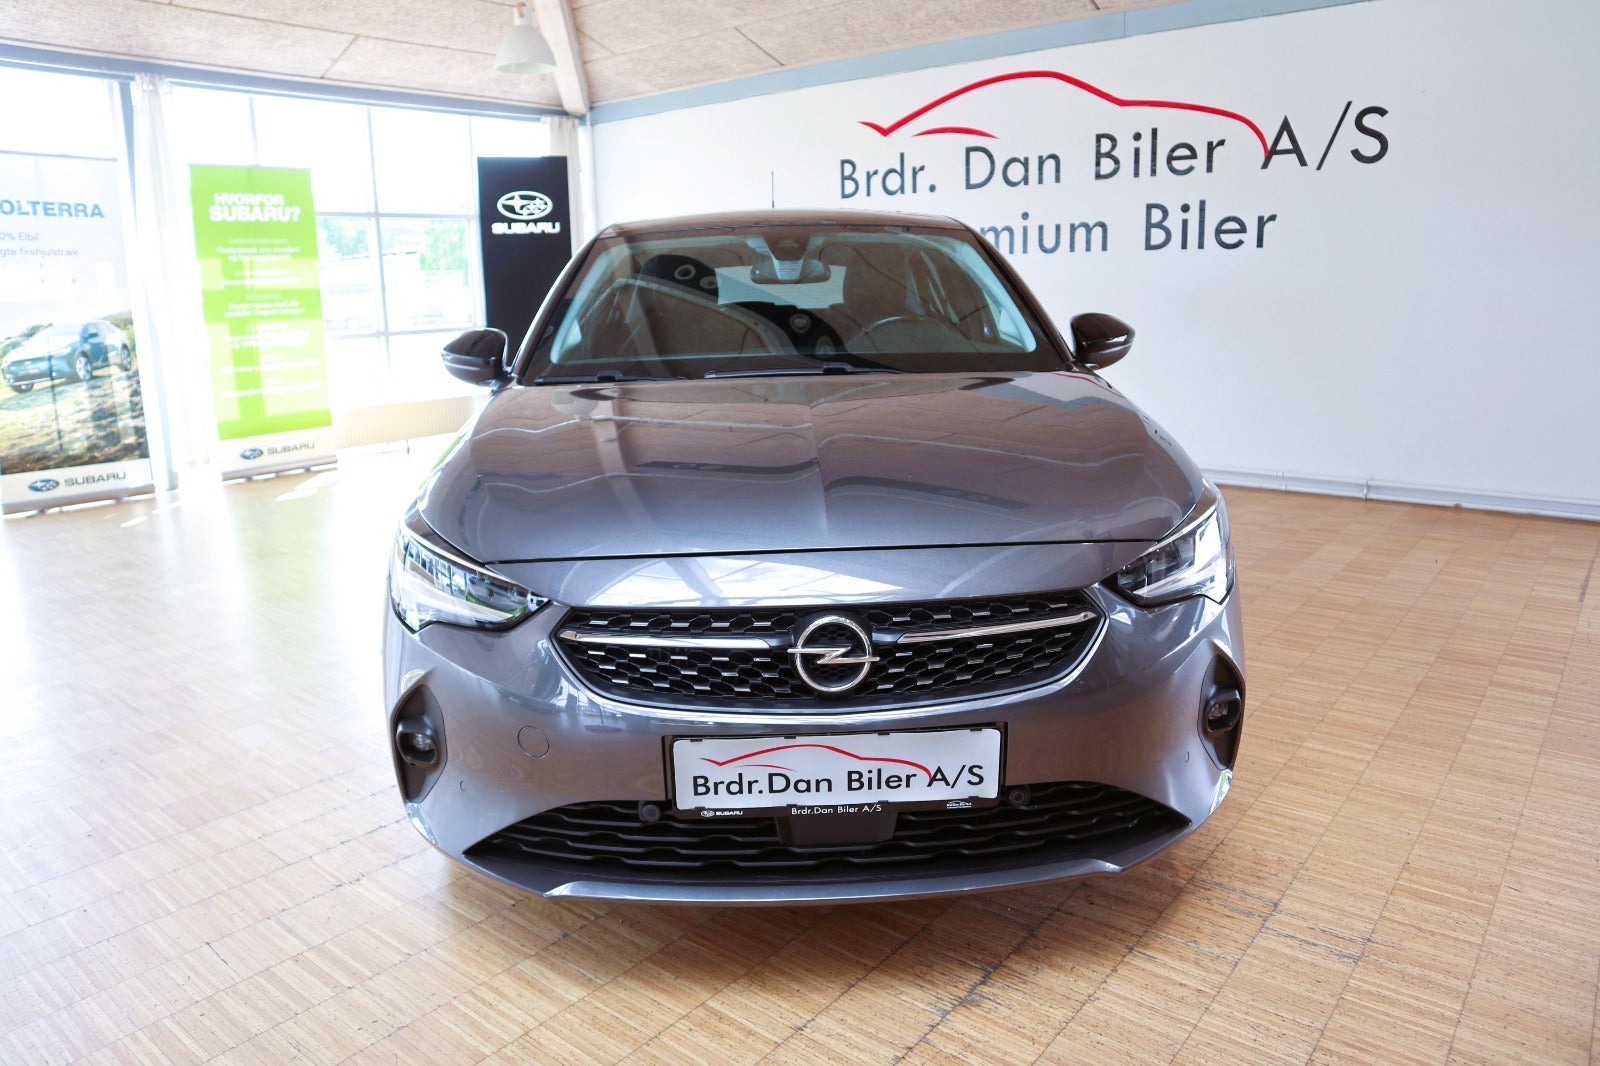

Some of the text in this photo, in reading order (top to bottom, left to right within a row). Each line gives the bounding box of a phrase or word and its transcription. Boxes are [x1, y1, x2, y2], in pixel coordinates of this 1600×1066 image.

[840, 100, 1391, 199] Brdr. Dan Biler A/S
[213, 192, 285, 206] HVORFOR
[208, 204, 302, 222] SUBARU?
[491, 221, 561, 234] SUBARU
[1144, 199, 1277, 250] Biler
[267, 442, 315, 456] SUBARU
[64, 471, 127, 487] SUBARU
[847, 768, 917, 792] Biler
[927, 764, 985, 789] A/S
[837, 805, 859, 814] Biler
[861, 803, 882, 813] A/S
